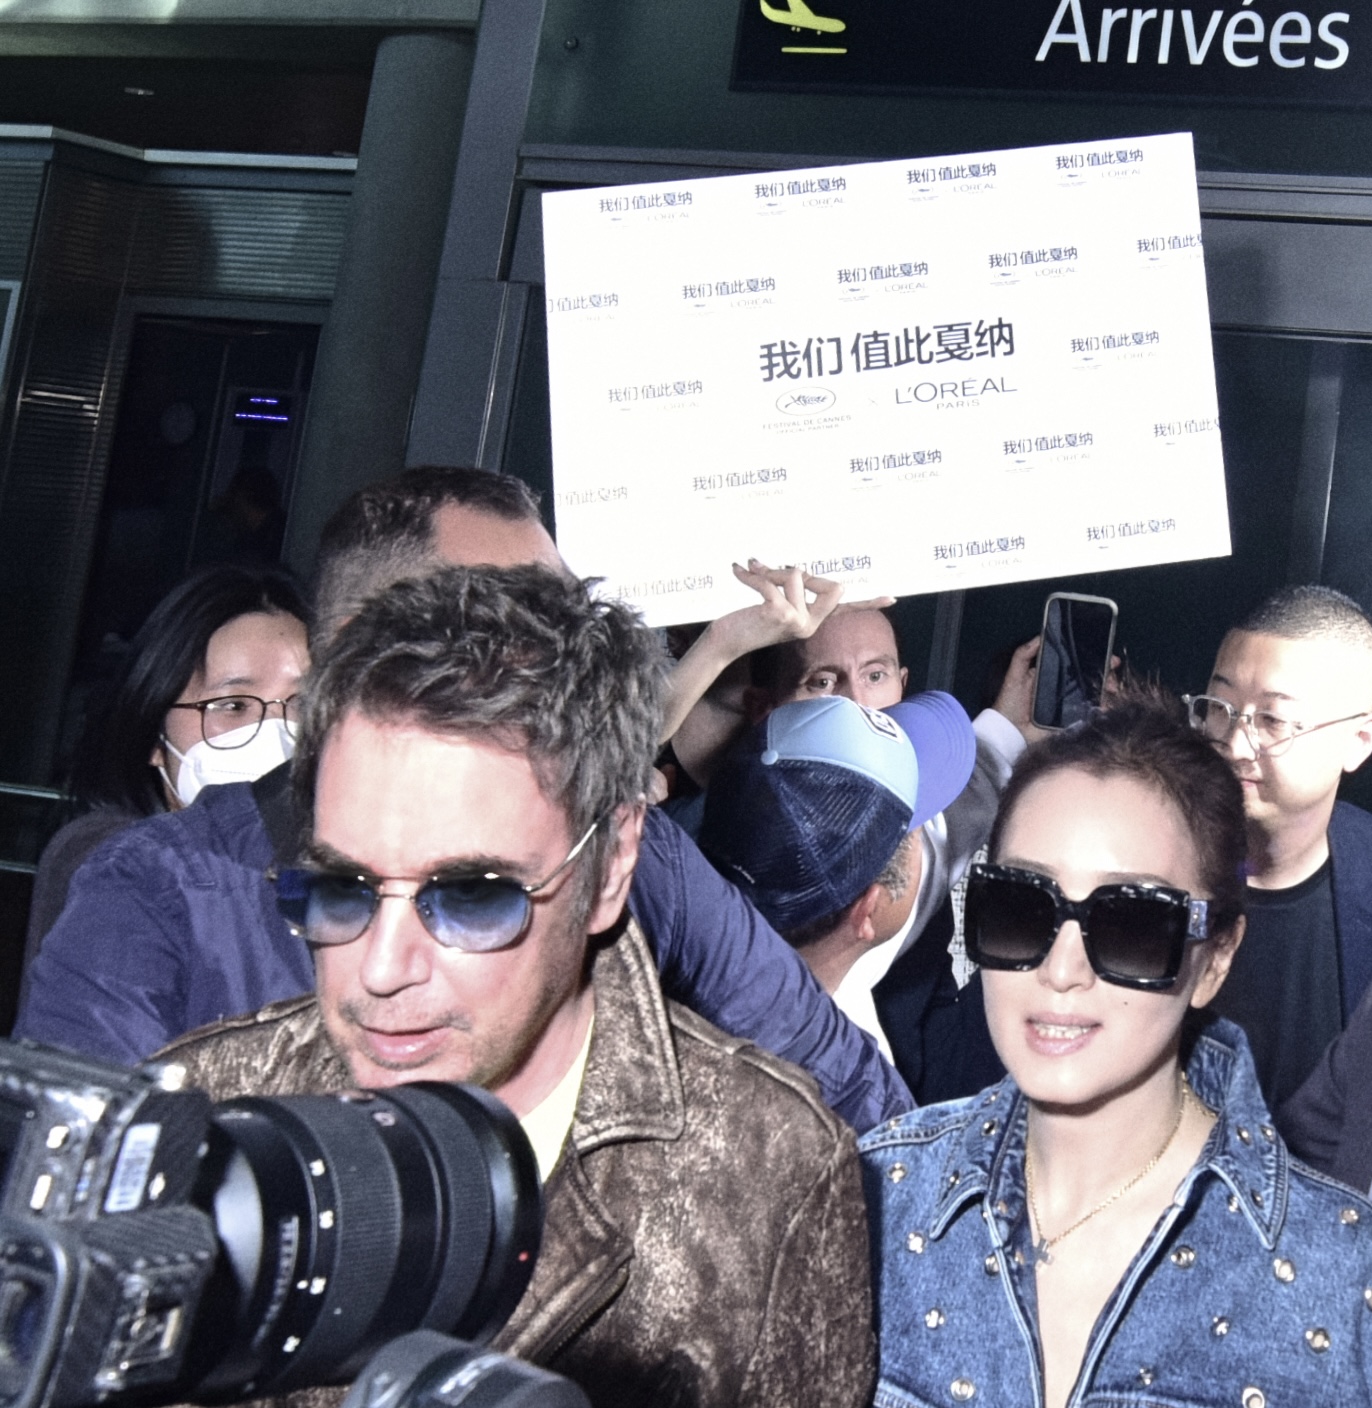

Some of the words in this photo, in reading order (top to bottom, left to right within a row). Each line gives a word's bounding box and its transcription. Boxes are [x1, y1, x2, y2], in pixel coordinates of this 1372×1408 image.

[1035, 0, 1350, 70] Arrivées
[759, 317, 1015, 382] 我们值此戛纳
